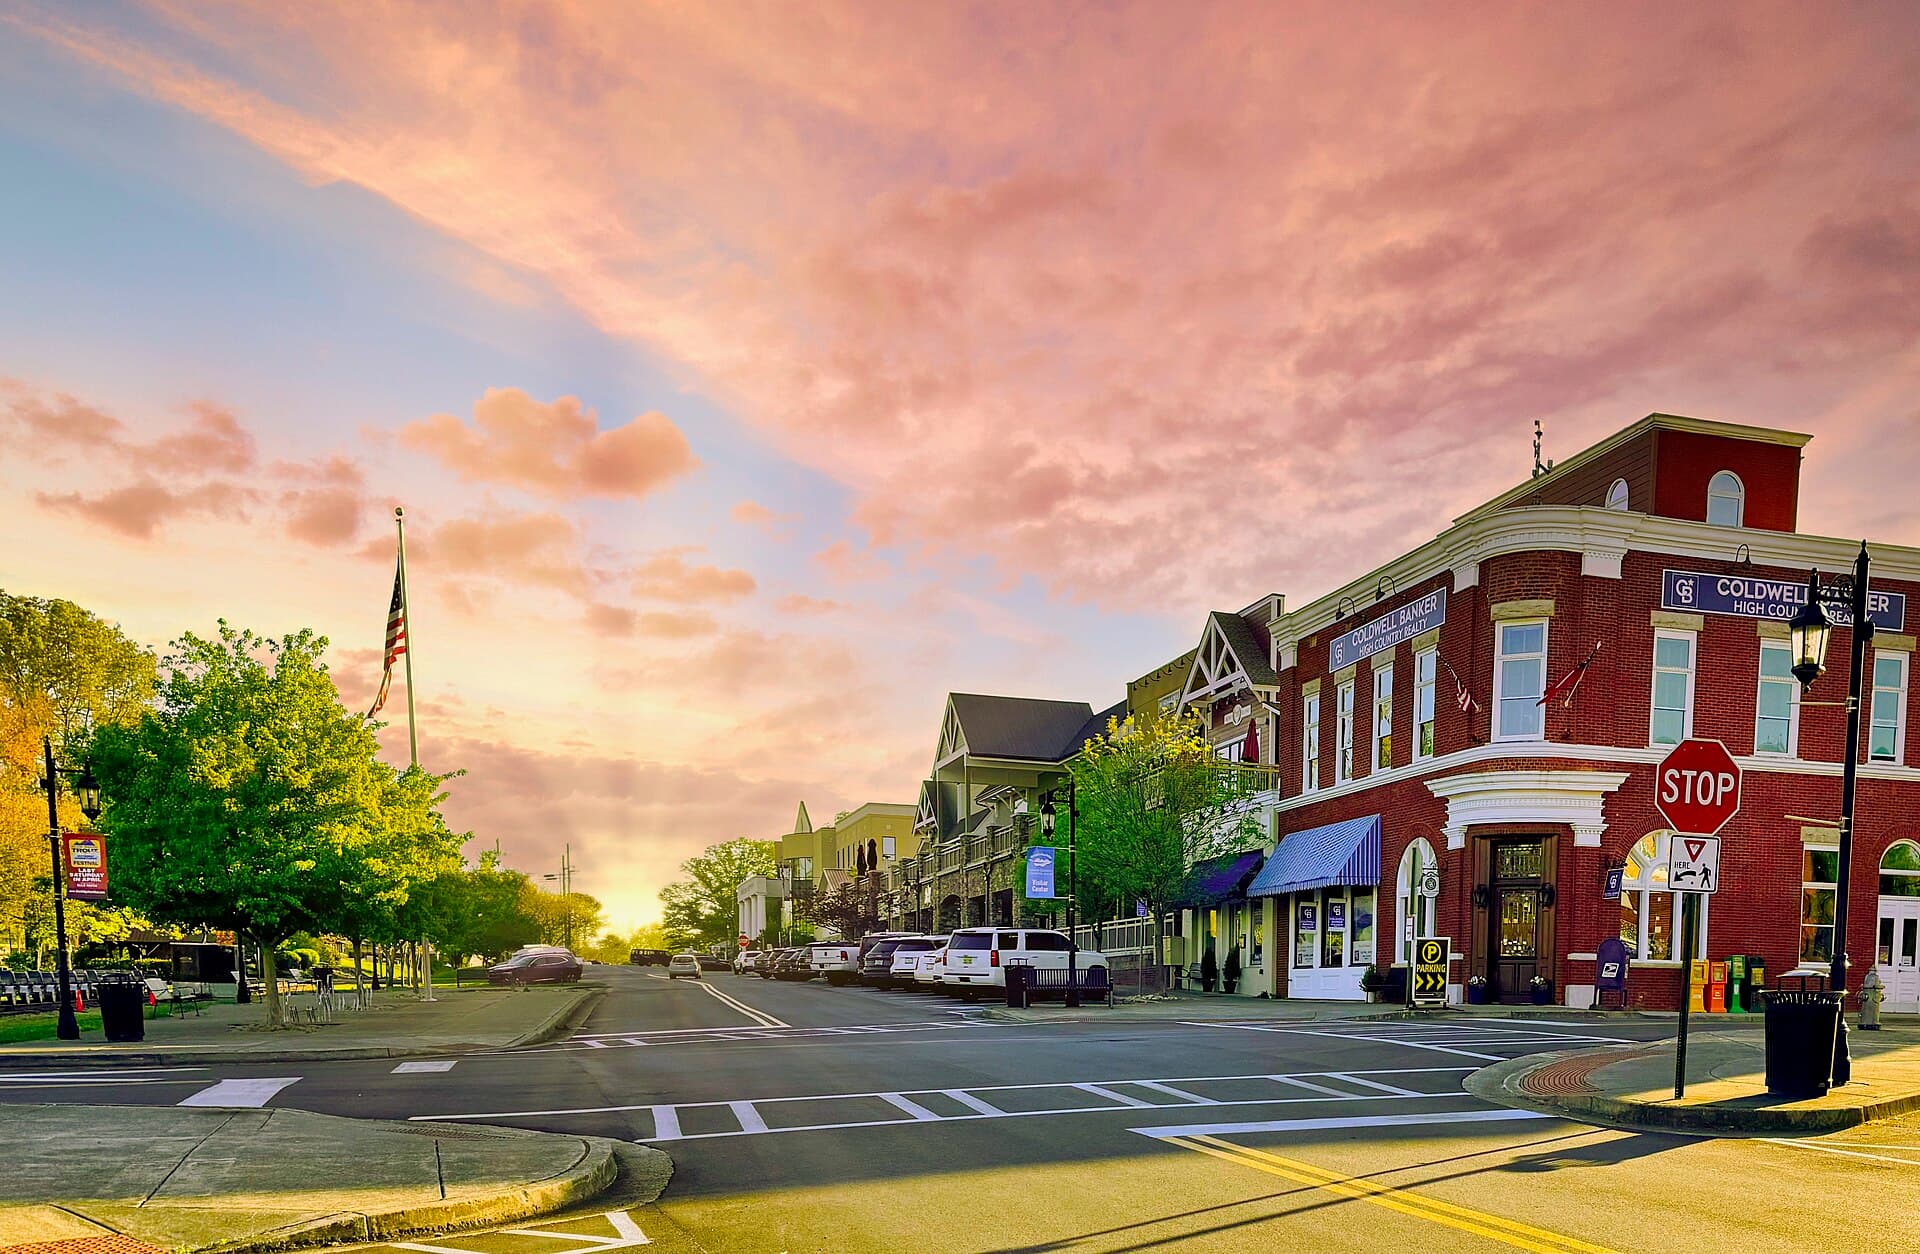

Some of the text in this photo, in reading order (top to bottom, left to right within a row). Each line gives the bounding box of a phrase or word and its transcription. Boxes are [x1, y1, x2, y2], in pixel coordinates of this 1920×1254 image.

[1734, 600, 1765, 615] HIGH
[1352, 595, 1437, 647] COLDWELL BANKER
[1359, 617, 1428, 657] HIGH COUNTRY REALTY
[1662, 768, 1735, 806] STOP
[1674, 860, 1691, 870] HERE
[1427, 945, 1438, 960] P
[1416, 963, 1446, 973] PARKING
